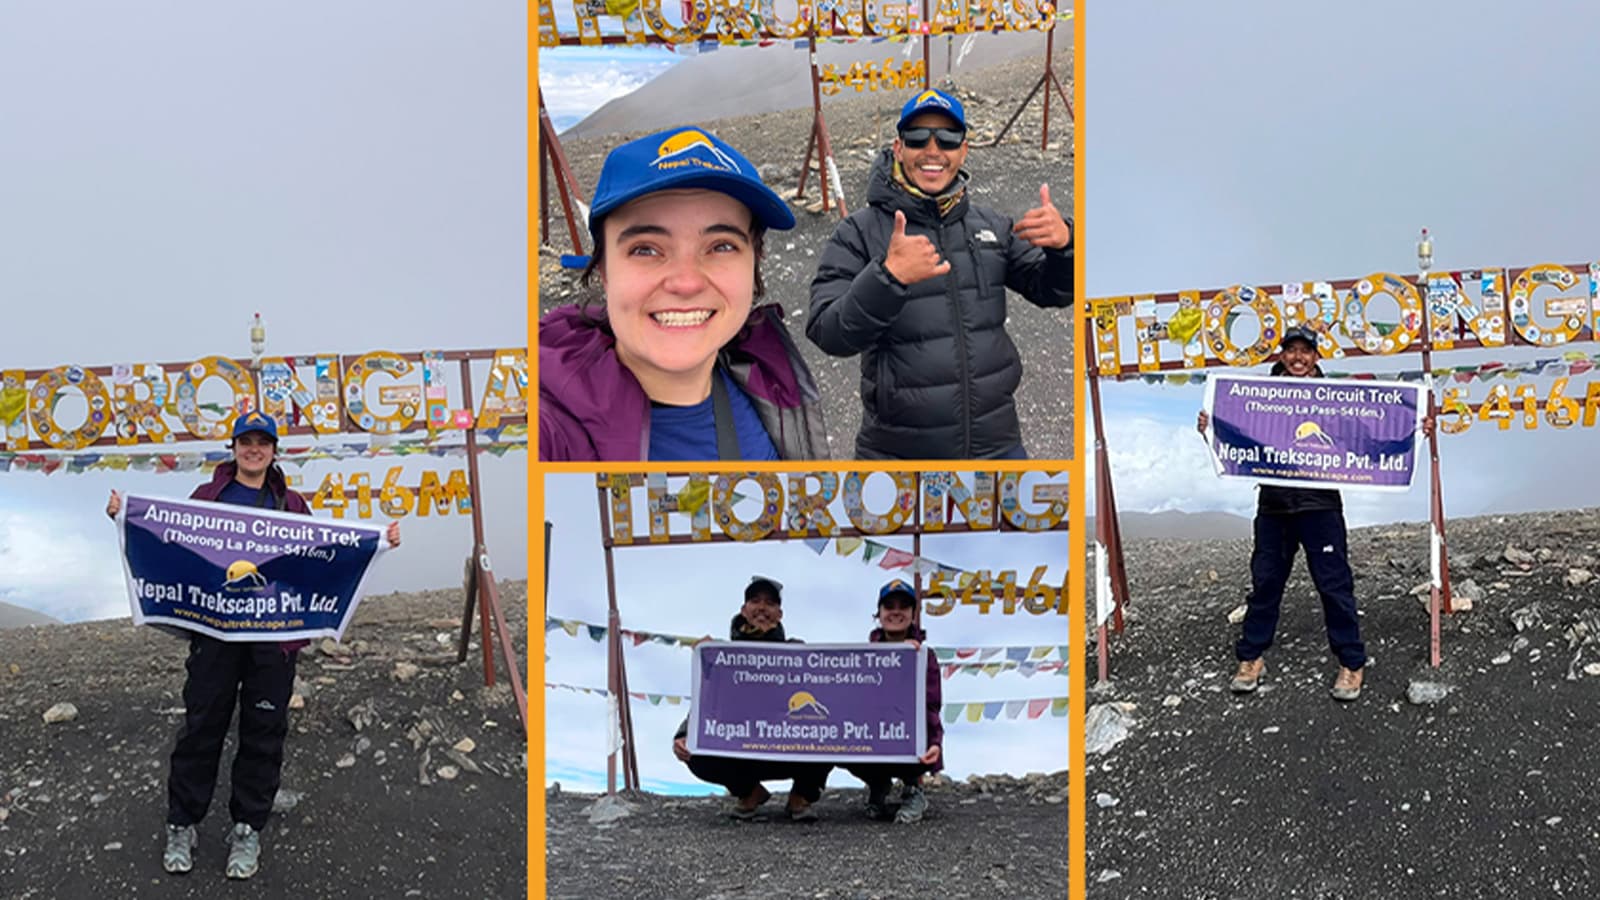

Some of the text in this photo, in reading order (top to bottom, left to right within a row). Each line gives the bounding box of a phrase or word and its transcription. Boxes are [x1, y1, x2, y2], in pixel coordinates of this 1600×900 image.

[822, 57, 927, 96] 5416M
[1230, 383, 1402, 404] Annapurna Circuit Trek
[1245, 402, 1293, 416] (Thorong
[1295, 404, 1308, 414] La
[1218, 443, 1408, 471] Nepal Trekscape Pvt. Ltd.
[285, 466, 474, 519] 416M
[143, 504, 362, 548] Annapurna Circuit Trek
[162, 528, 224, 551] (Thorong
[227, 535, 244, 551] La
[133, 578, 339, 618] Nepal Trekscape Pvt. Ltd.
[715, 651, 901, 670] Annapurna Circuit Trek
[733, 671, 785, 686] (Thorong
[787, 672, 801, 684] La
[704, 718, 910, 743] Nepal Trekscape Pvt. Ltd.
